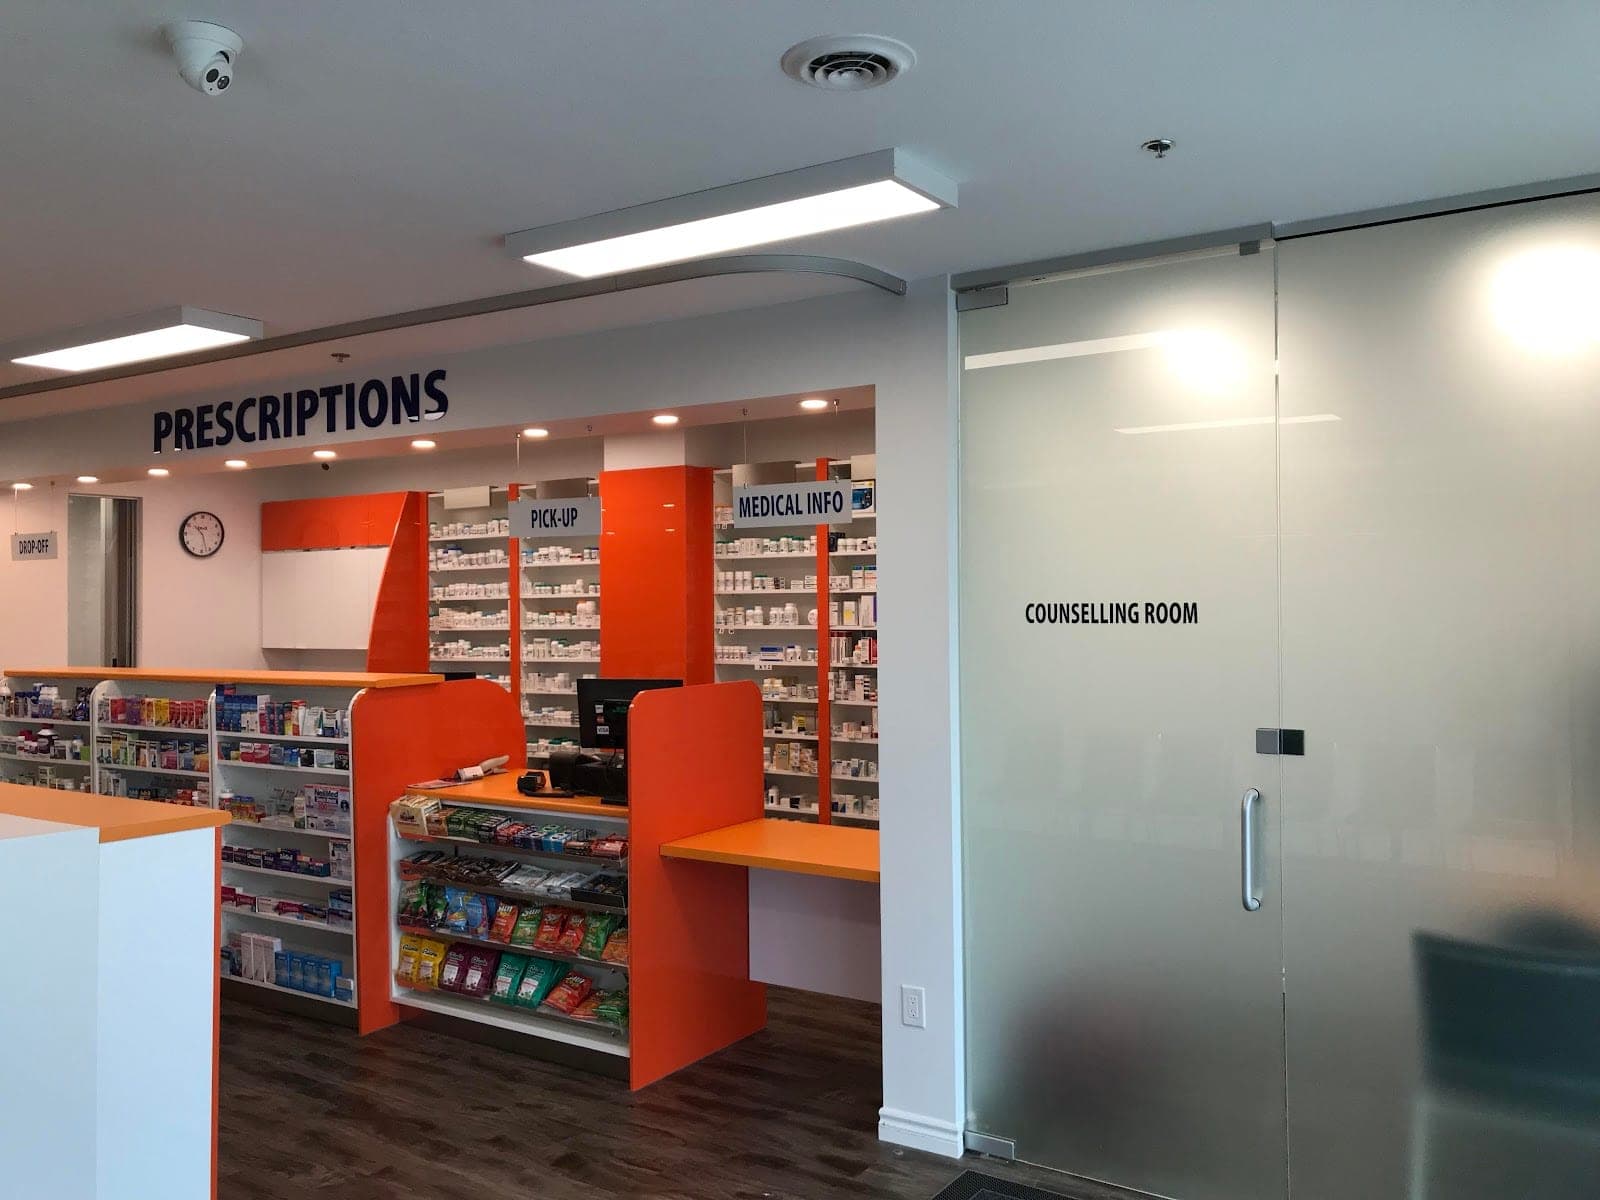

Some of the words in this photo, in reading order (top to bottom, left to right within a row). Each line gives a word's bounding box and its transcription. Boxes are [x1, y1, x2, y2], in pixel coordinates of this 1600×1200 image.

[153, 369, 449, 454] PRESCRIPTIONS
[739, 493, 803, 518] MEDICAL
[807, 490, 843, 513] INFO
[531, 507, 578, 529] PICK-UP
[19, 539, 49, 554] DROP-OFF
[1025, 602, 1140, 624] COUNSELLING
[1144, 602, 1198, 624] ROOM
